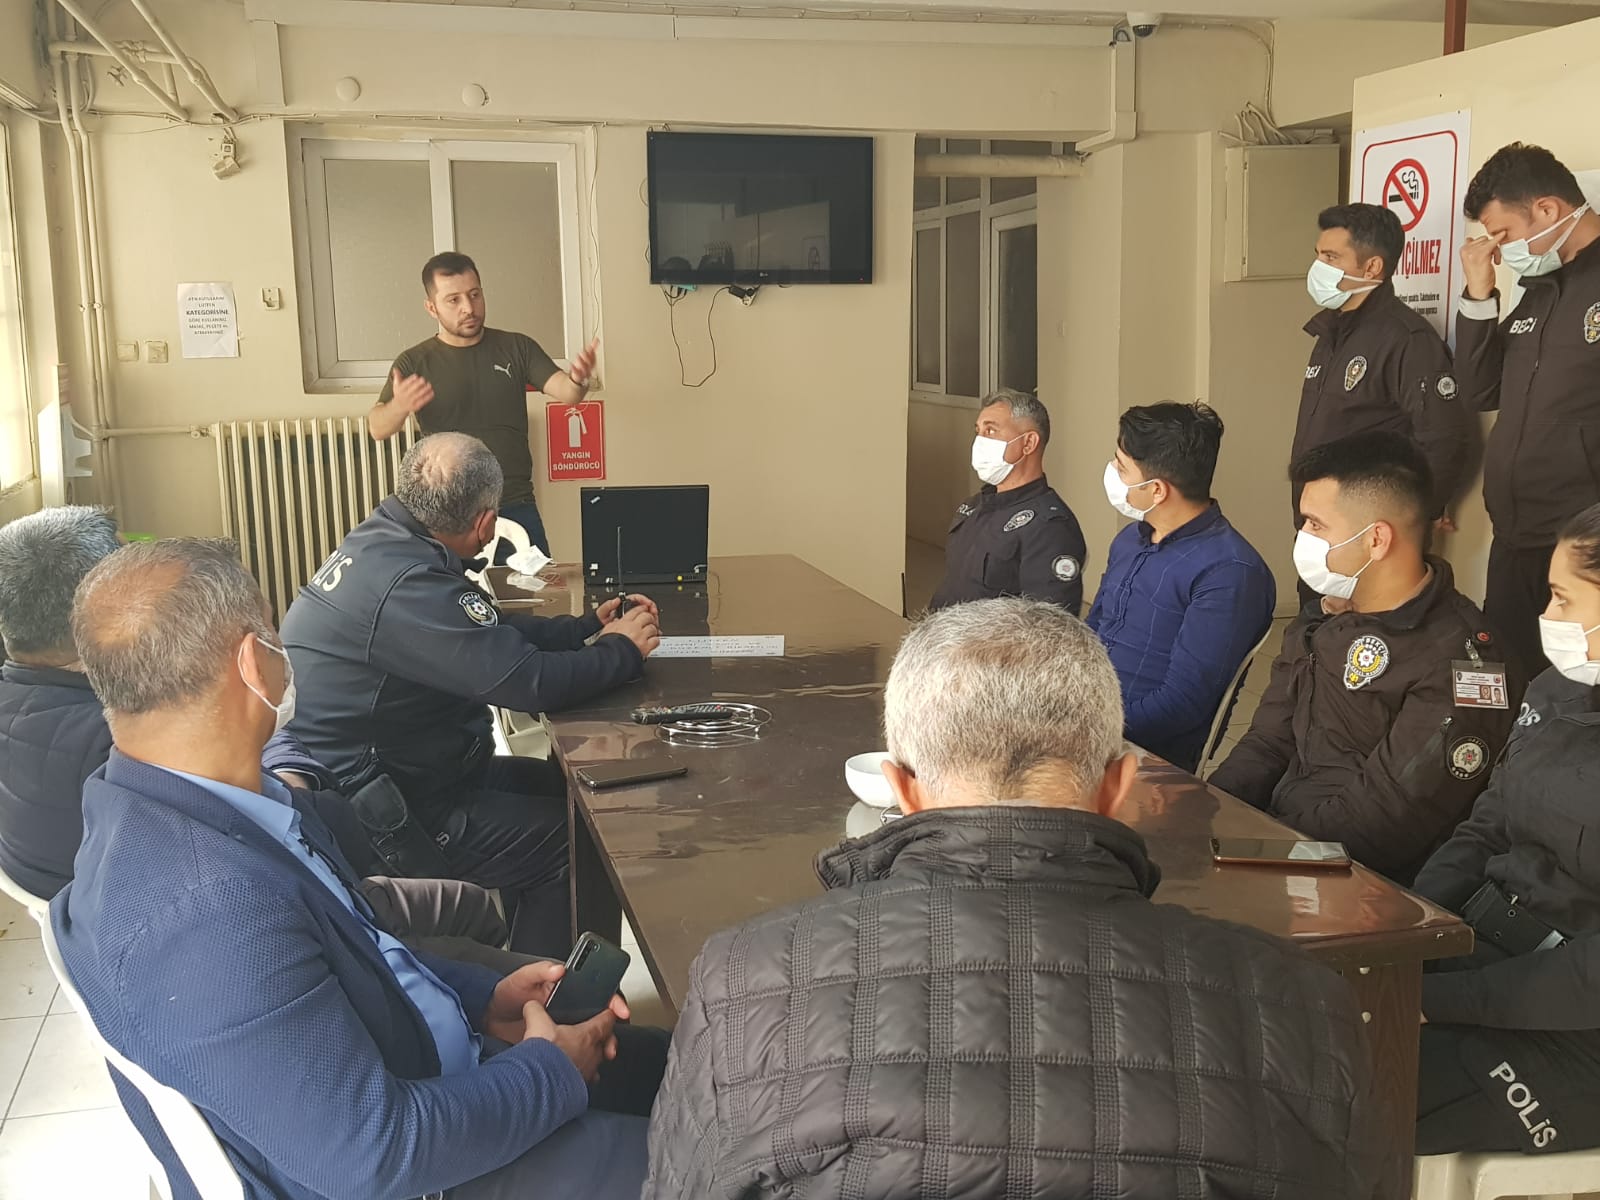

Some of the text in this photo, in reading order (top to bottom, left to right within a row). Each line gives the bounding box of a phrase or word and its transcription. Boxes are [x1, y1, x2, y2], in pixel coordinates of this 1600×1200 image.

[561, 451, 591, 460] YANGIN
[552, 461, 600, 471] SÖNDÜRÜCÜ
[1488, 1060, 1558, 1148] POLİS
